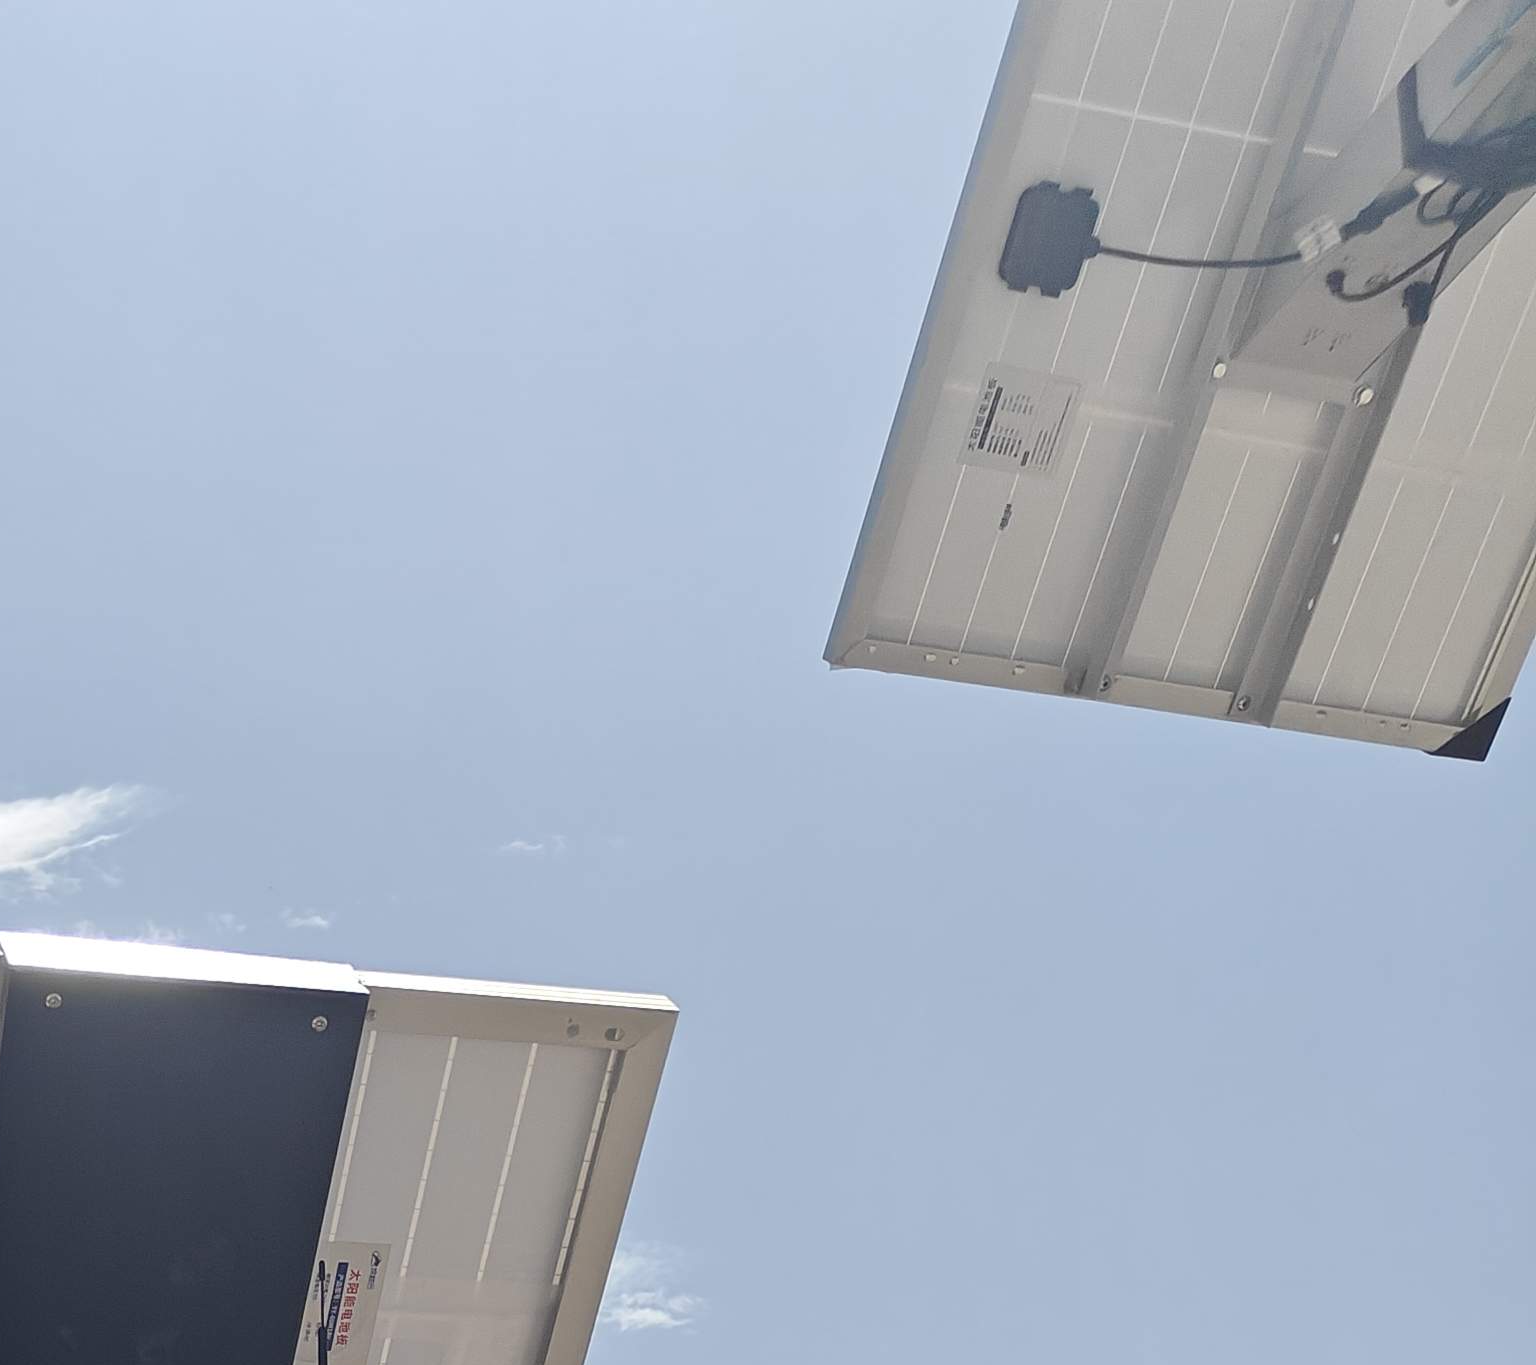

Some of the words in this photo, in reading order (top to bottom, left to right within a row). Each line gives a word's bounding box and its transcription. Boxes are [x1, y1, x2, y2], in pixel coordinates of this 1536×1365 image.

[335, 1269, 361, 1345] 太阳能电池板
